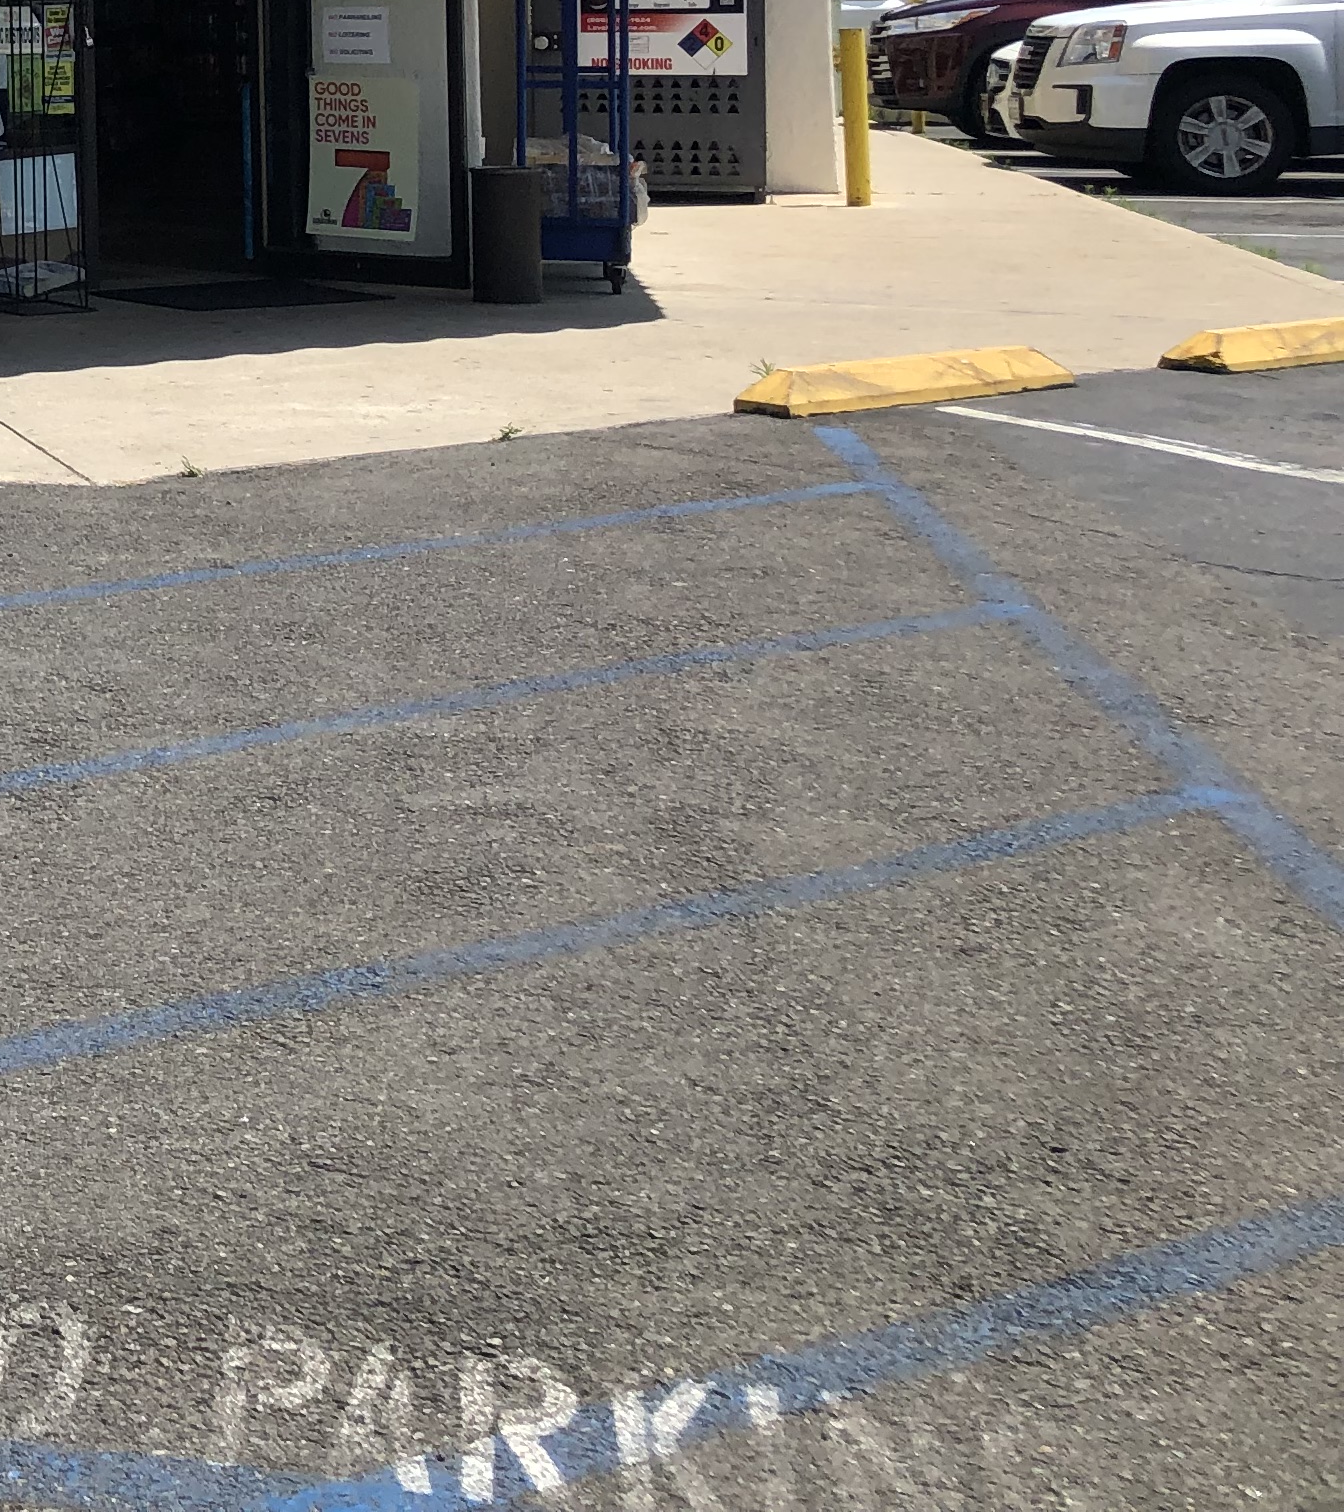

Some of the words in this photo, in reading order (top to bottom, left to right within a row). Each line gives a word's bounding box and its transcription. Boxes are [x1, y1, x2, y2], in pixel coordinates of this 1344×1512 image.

[714, 36, 724, 51] 0
[314, 82, 361, 97] GOOD
[314, 97, 368, 114] THINGS
[315, 113, 358, 128] COME
[362, 115, 377, 129] IN
[315, 129, 370, 145] SEVENS
